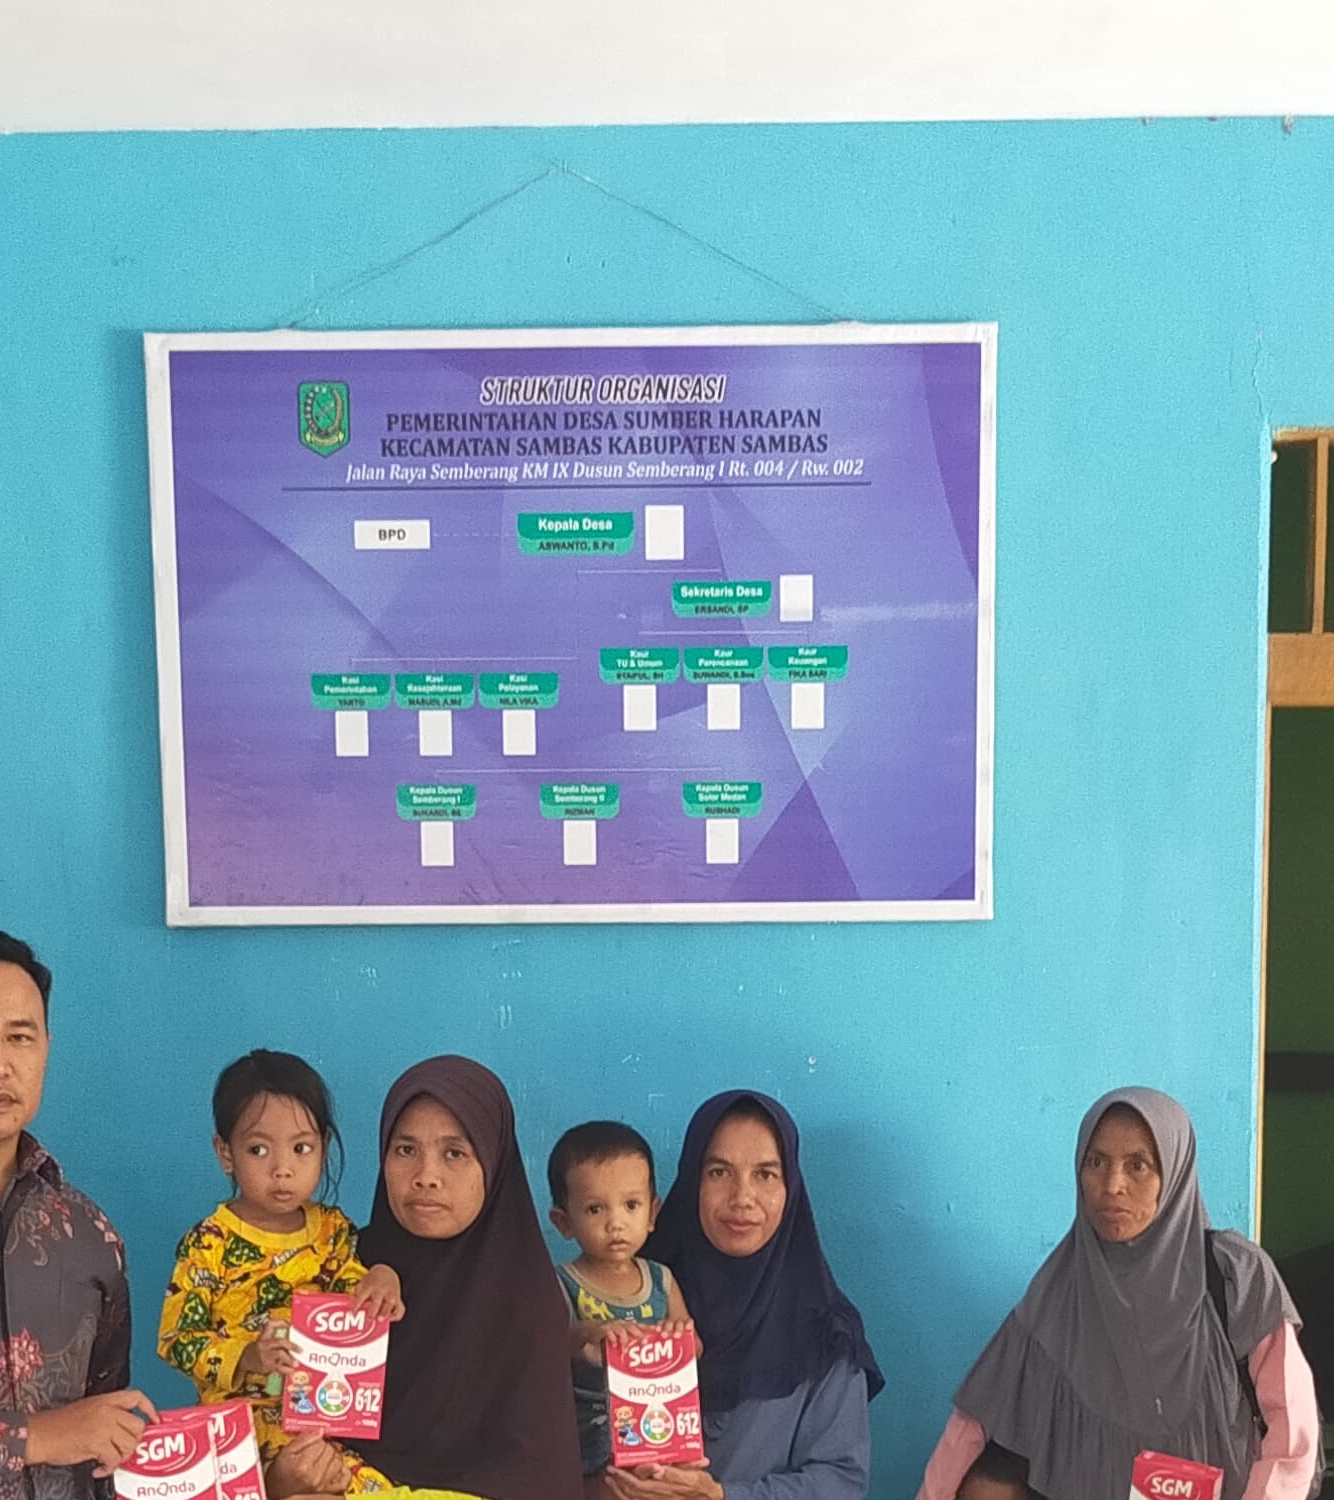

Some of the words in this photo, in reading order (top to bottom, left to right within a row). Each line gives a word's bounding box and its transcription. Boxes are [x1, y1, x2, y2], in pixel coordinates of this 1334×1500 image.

[481, 376, 594, 405] STRUKTUR
[598, 375, 725, 403] ORGANISASI
[386, 412, 557, 433] PEMERINTAHAN
[564, 411, 618, 431] DESA
[623, 410, 712, 431] SUMBER
[719, 408, 821, 429] HARAPAN
[381, 438, 510, 458] KECAMATAN
[517, 436, 603, 456] SAMBAS
[608, 435, 736, 455] KABUPATEN
[742, 433, 828, 453] SAMBAS
[346, 464, 385, 483] Jalan
[389, 464, 426, 484] Raya
[430, 462, 519, 483] Semberang
[522, 462, 548, 479] KM
[552, 462, 570, 479] IX
[573, 462, 623, 480] Dusun
[626, 459, 715, 480] Semberang
[728, 459, 749, 477] Rt.
[754, 459, 785, 476] 004
[786, 459, 798, 480] /
[801, 458, 829, 476] Rw.
[833, 458, 864, 476] 002
[378, 528, 407, 542] BPD
[538, 518, 580, 534] Kepala
[583, 518, 613, 531] Desa
[680, 585, 734, 598] Sekretaris
[736, 585, 763, 597] Desa
[314, 1310, 366, 1333] SGM
[629, 1339, 673, 1368] SGM
[136, 1432, 186, 1465] SGM
[1150, 1476, 1193, 1499] SGM
